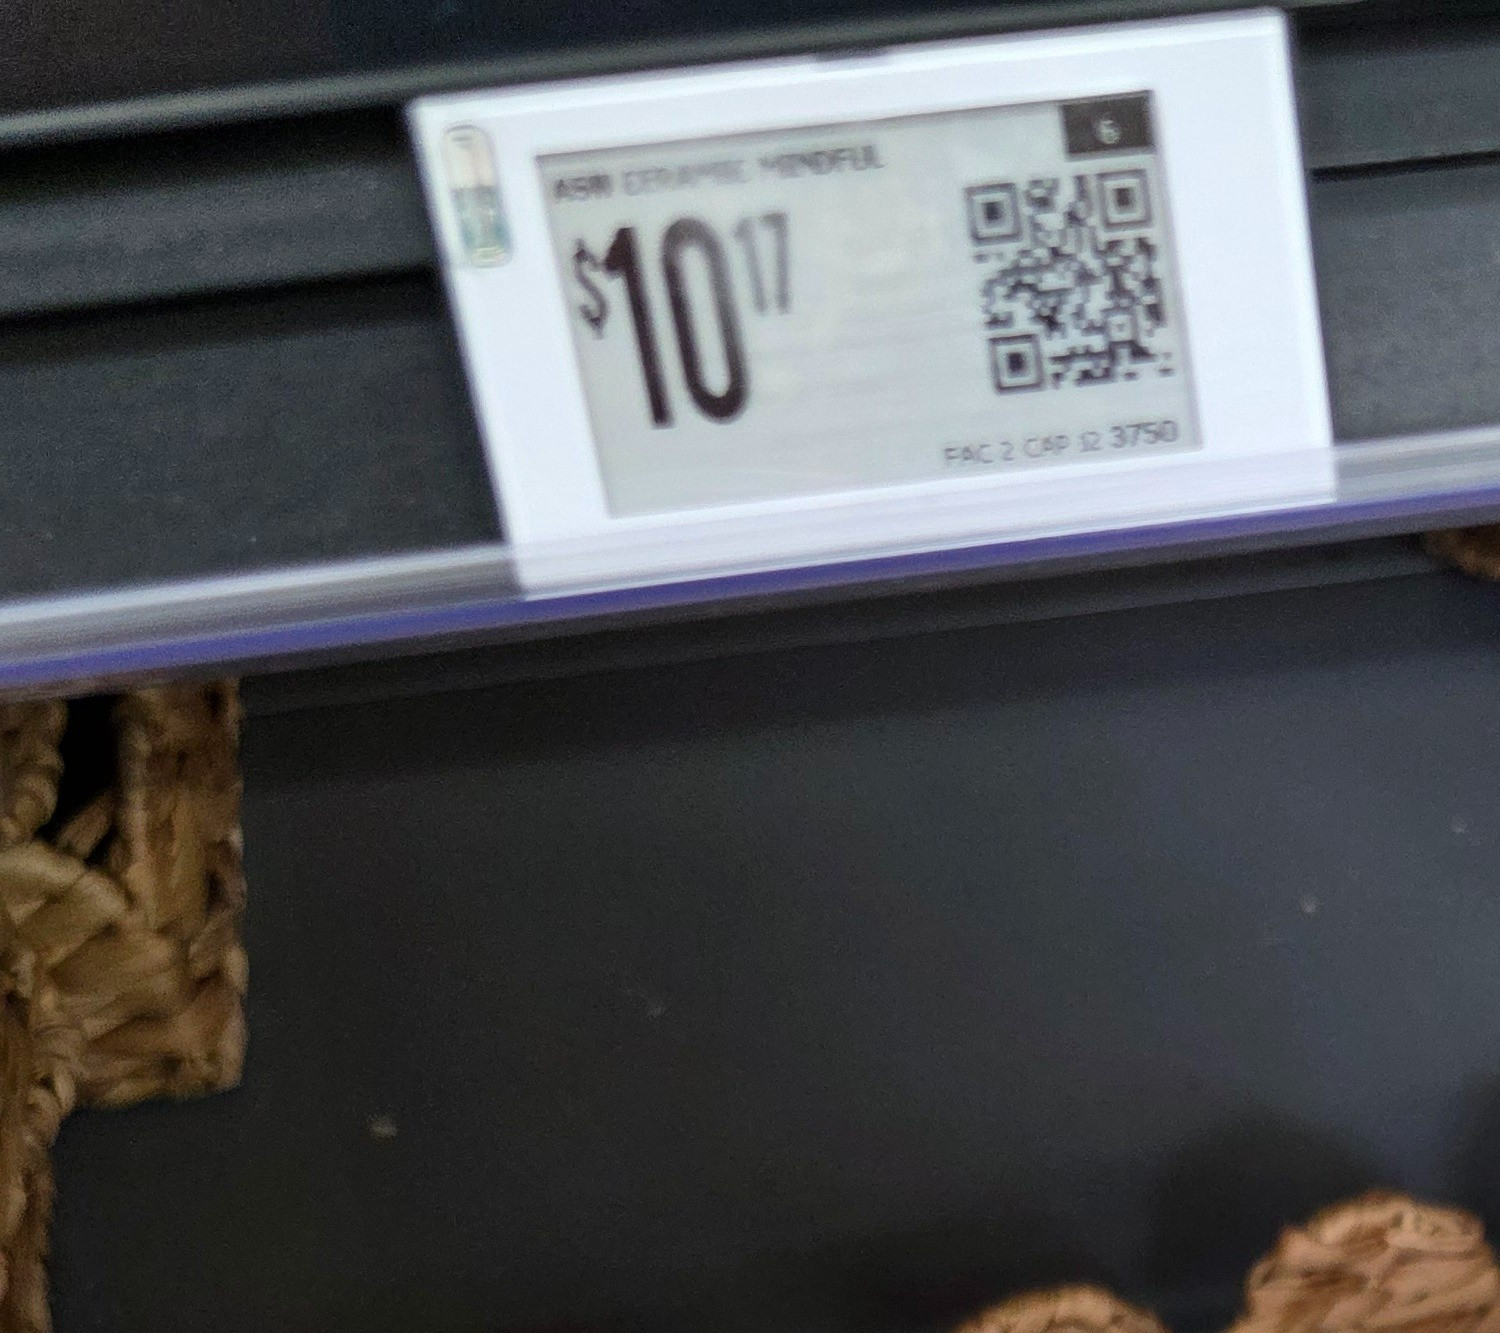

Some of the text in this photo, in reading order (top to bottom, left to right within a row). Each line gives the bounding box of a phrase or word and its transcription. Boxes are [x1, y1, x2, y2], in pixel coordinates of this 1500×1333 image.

[1000, 441, 1016, 461] 2
[1023, 434, 1070, 458] CAP
[1110, 420, 1178, 448] 3750
